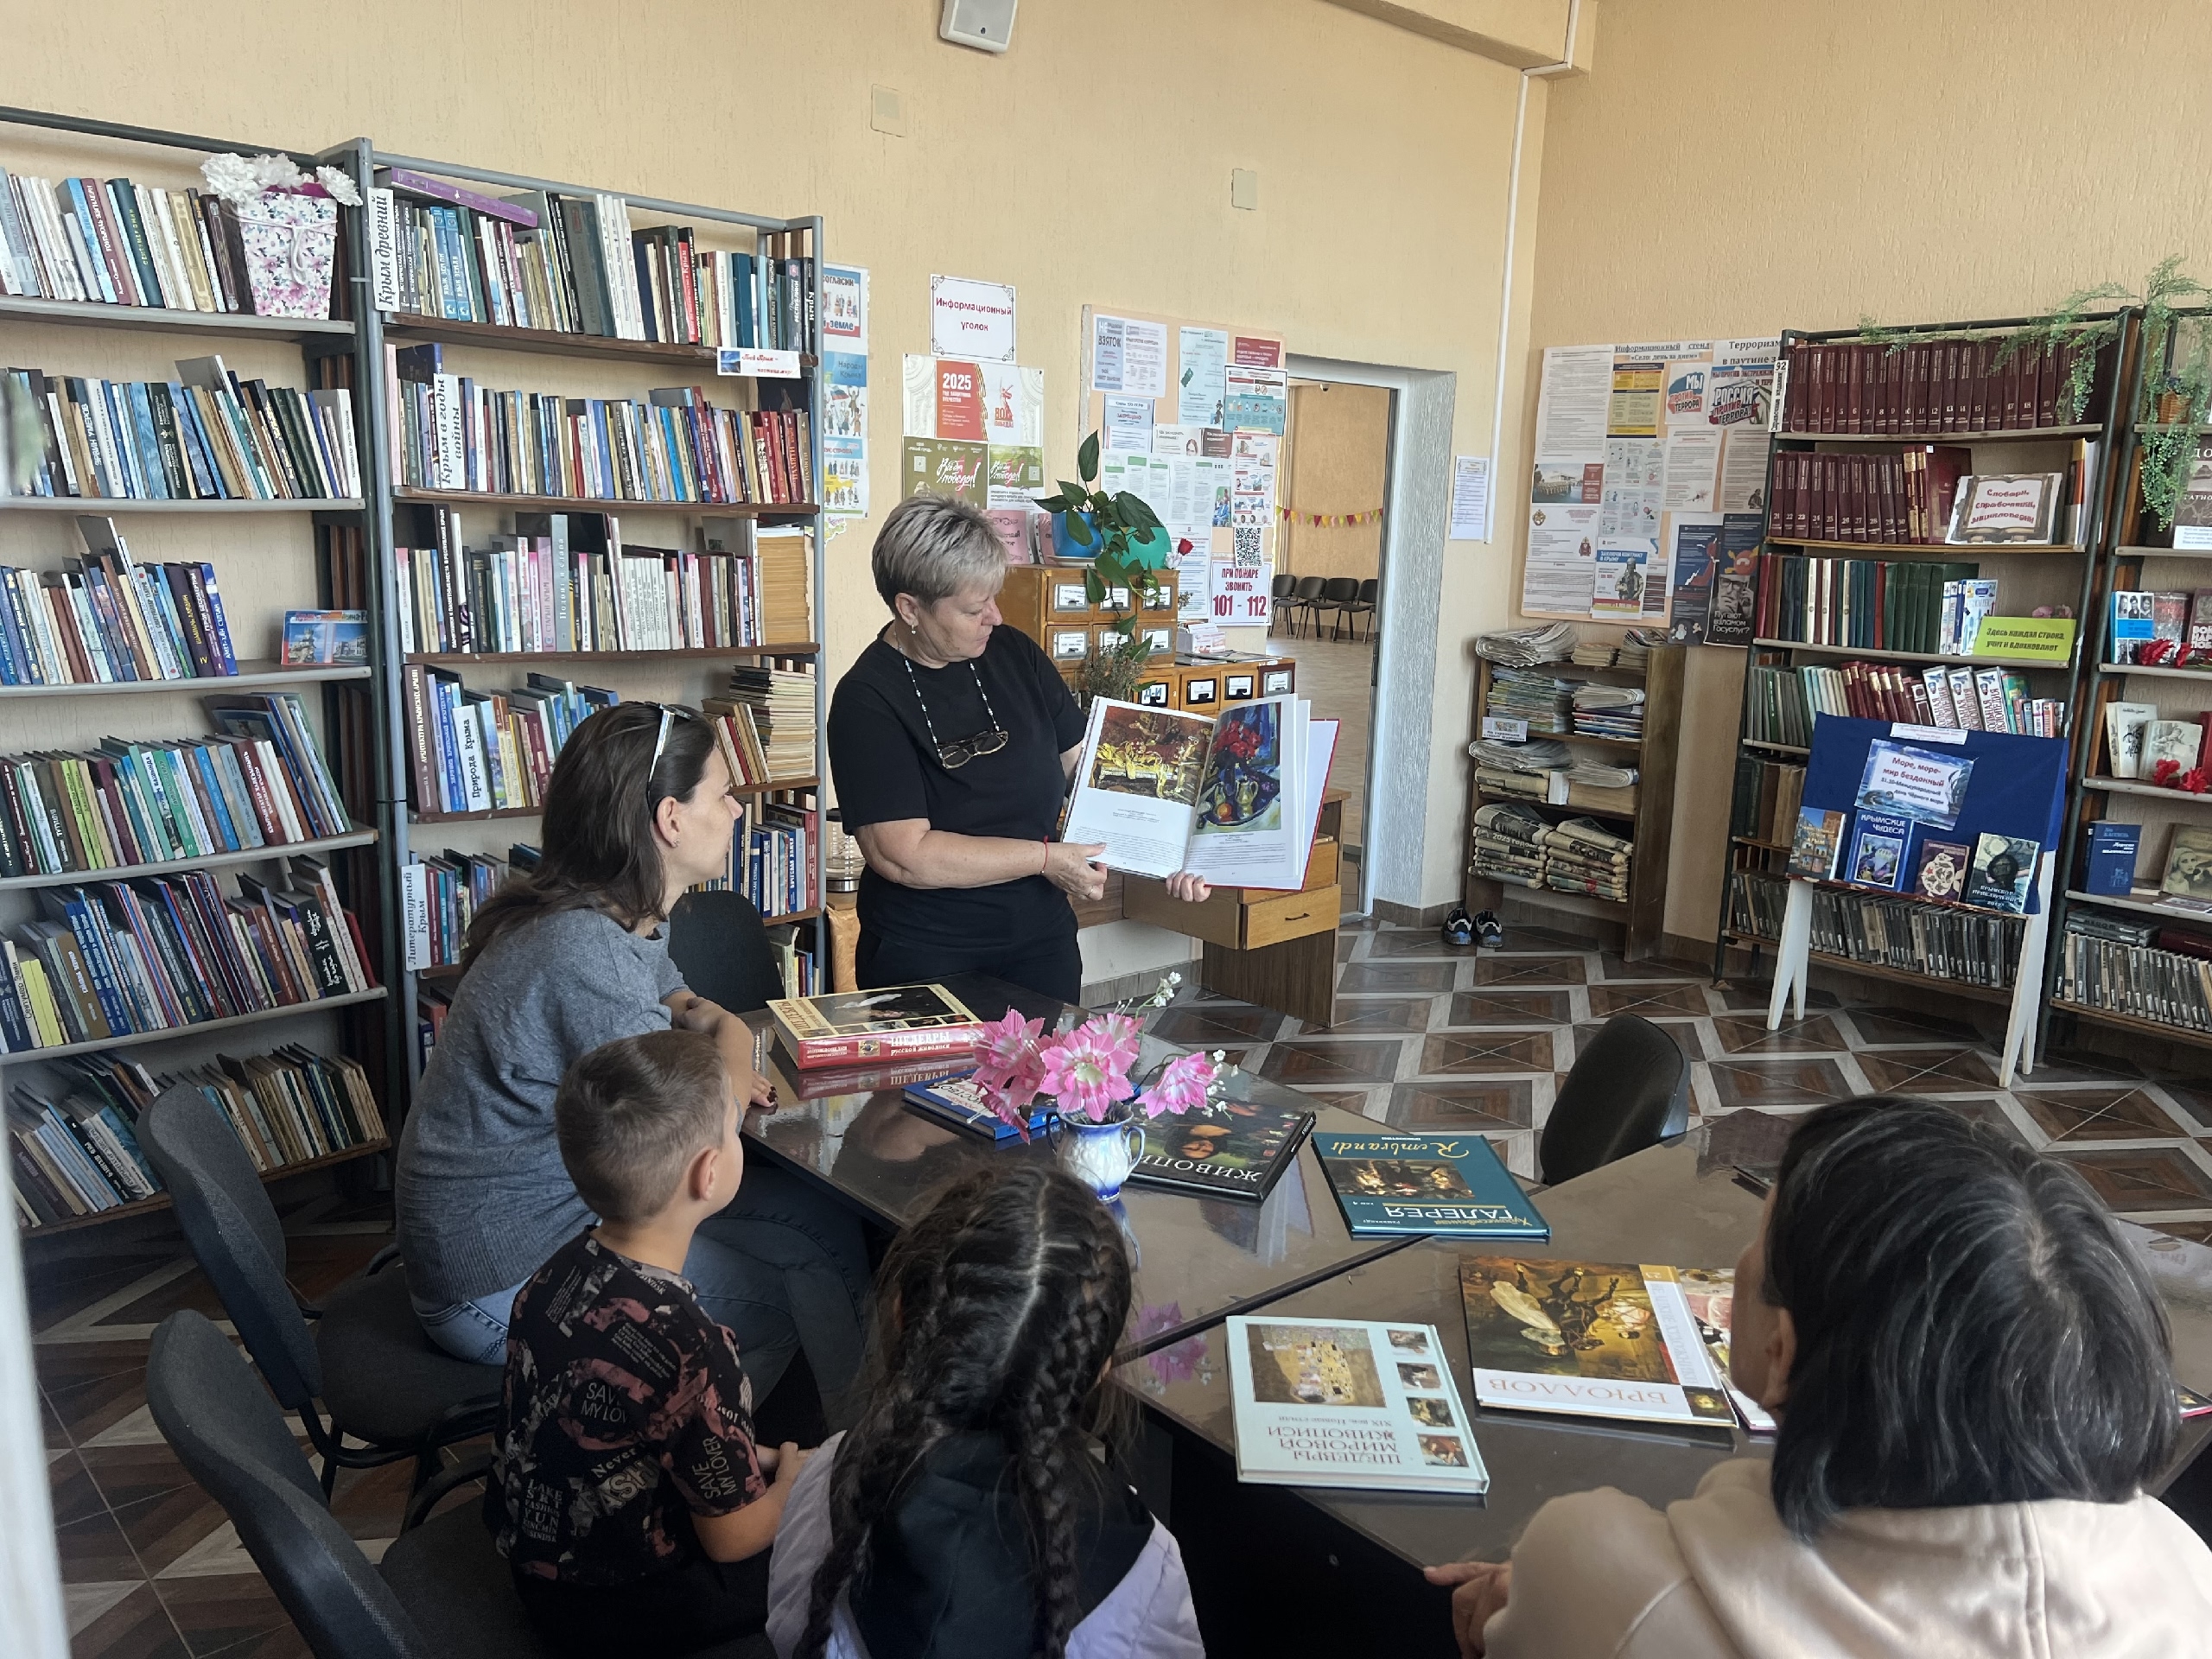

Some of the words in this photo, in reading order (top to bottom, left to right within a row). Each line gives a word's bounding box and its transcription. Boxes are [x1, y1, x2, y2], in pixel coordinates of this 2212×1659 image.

[372, 195, 392, 258] древний
[378, 261, 396, 307] Крым
[936, 297, 1012, 315] Информационный
[830, 321, 854, 330] земле
[961, 321, 988, 332] уголок
[1615, 344, 1681, 353] Информационный
[943, 373, 972, 391] 2025
[1686, 374, 1705, 390] МЫ
[435, 378, 447, 421] годы
[1670, 391, 1694, 404] ПРОТИВ
[1714, 387, 1754, 406] РОССИЯ
[1675, 399, 1700, 413] ТЕРРОРА
[1713, 400, 1741, 416] ПРОТИВ
[81, 403, 95, 437] УМЕРОВ
[1718, 408, 1751, 424] ТЕРРОРА!
[440, 423, 448, 433] в
[452, 407, 462, 460] войны
[442, 436, 453, 484] Крым
[1222, 568, 1234, 578] ПРИ
[1234, 568, 1259, 579] ПОЖАРЕ
[1225, 582, 1253, 591] ЗВОНИТЬ
[1213, 594, 1233, 616] 101
[1247, 595, 1267, 616] 112
[1713, 618, 1746, 626] взломом
[1714, 610, 1742, 621] Пугают
[1713, 625, 1751, 635] Госуслуг?
[2009, 630, 2037, 639] каждая
[218, 628, 232, 659] АМЕТ-ХАН
[2009, 642, 2058, 652] вдохновляет
[463, 719, 475, 749] Крыма
[1892, 758, 1916, 770] Море,
[467, 755, 480, 798] Природа
[1883, 768, 1898, 778] мир
[1900, 771, 1945, 787] бездонный
[1861, 814, 1906, 827] КРЫМСКИЕ
[1873, 824, 1905, 836] ЧУДЕСА
[404, 872, 416, 965] Литературный
[418, 900, 428, 934] Крым
[891, 1031, 950, 1046] ШЕДЕВРЫ
[891, 1047, 917, 1056] русской
[918, 1044, 950, 1052] живописи
[1331, 1141, 1470, 1159] Rembrandt
[1142, 1154, 1262, 1182] ЖИВОПИ
[1384, 1206, 1512, 1219] ГАЛЕРЕЯ
[1489, 1378, 1670, 1405] БРЮЛЛОВ
[581, 1400, 602, 1417] MY
[1266, 1426, 1396, 1440] ЖИВОПИСИ
[1279, 1439, 1396, 1452] МИРОВОЙ
[591, 1448, 636, 1478] Never
[702, 1436, 730, 1476] LOVER
[1294, 1451, 1401, 1465] ШЕДЕВРЫ
[691, 1461, 721, 1499] SAVE
[719, 1478, 737, 1496] MY
